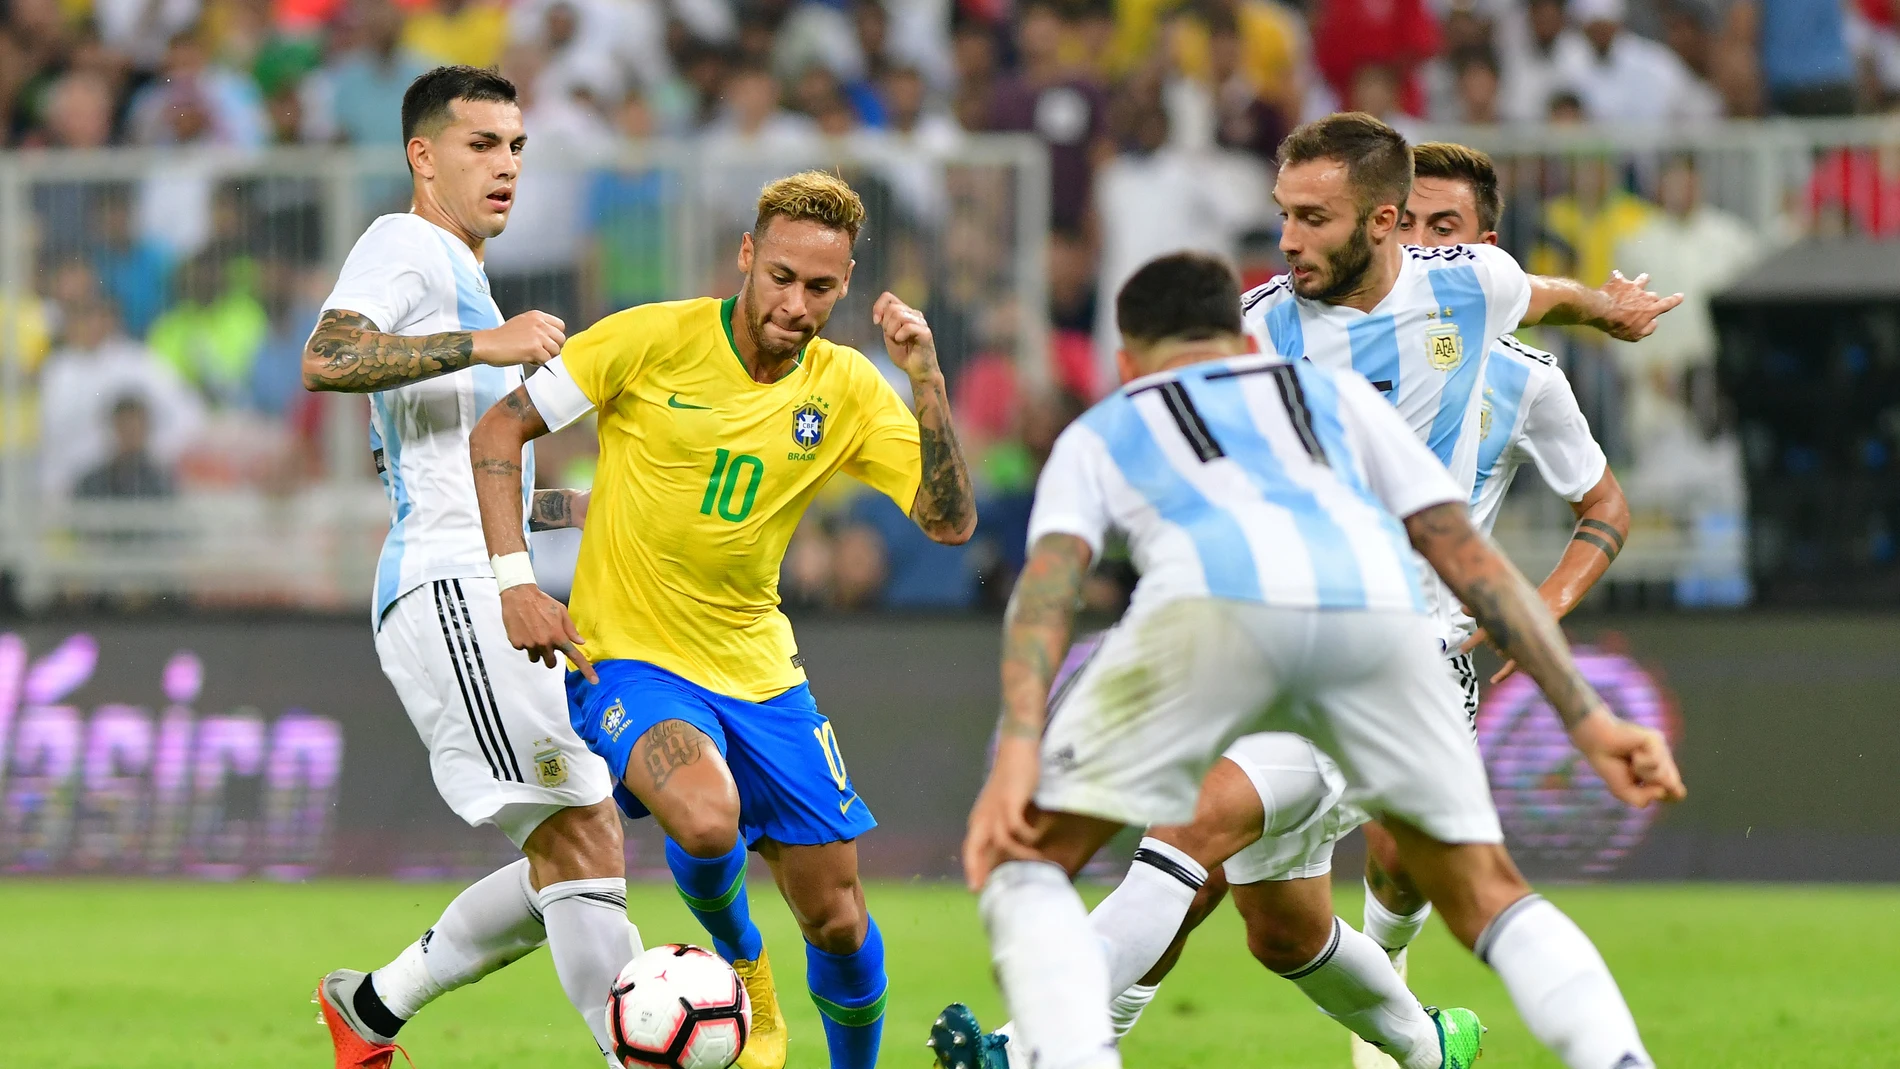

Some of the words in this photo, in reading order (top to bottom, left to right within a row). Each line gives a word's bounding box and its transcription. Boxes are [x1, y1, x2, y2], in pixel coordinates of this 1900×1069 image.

[1435, 337, 1455, 358] AFA
[802, 422, 815, 430] CBF
[1127, 364, 1333, 468] 17
[788, 452, 816, 461] BRASIL
[700, 448, 764, 523] 10
[612, 719, 633, 742] BRASIL
[813, 720, 847, 791] 10
[543, 759, 562, 777] AFA
